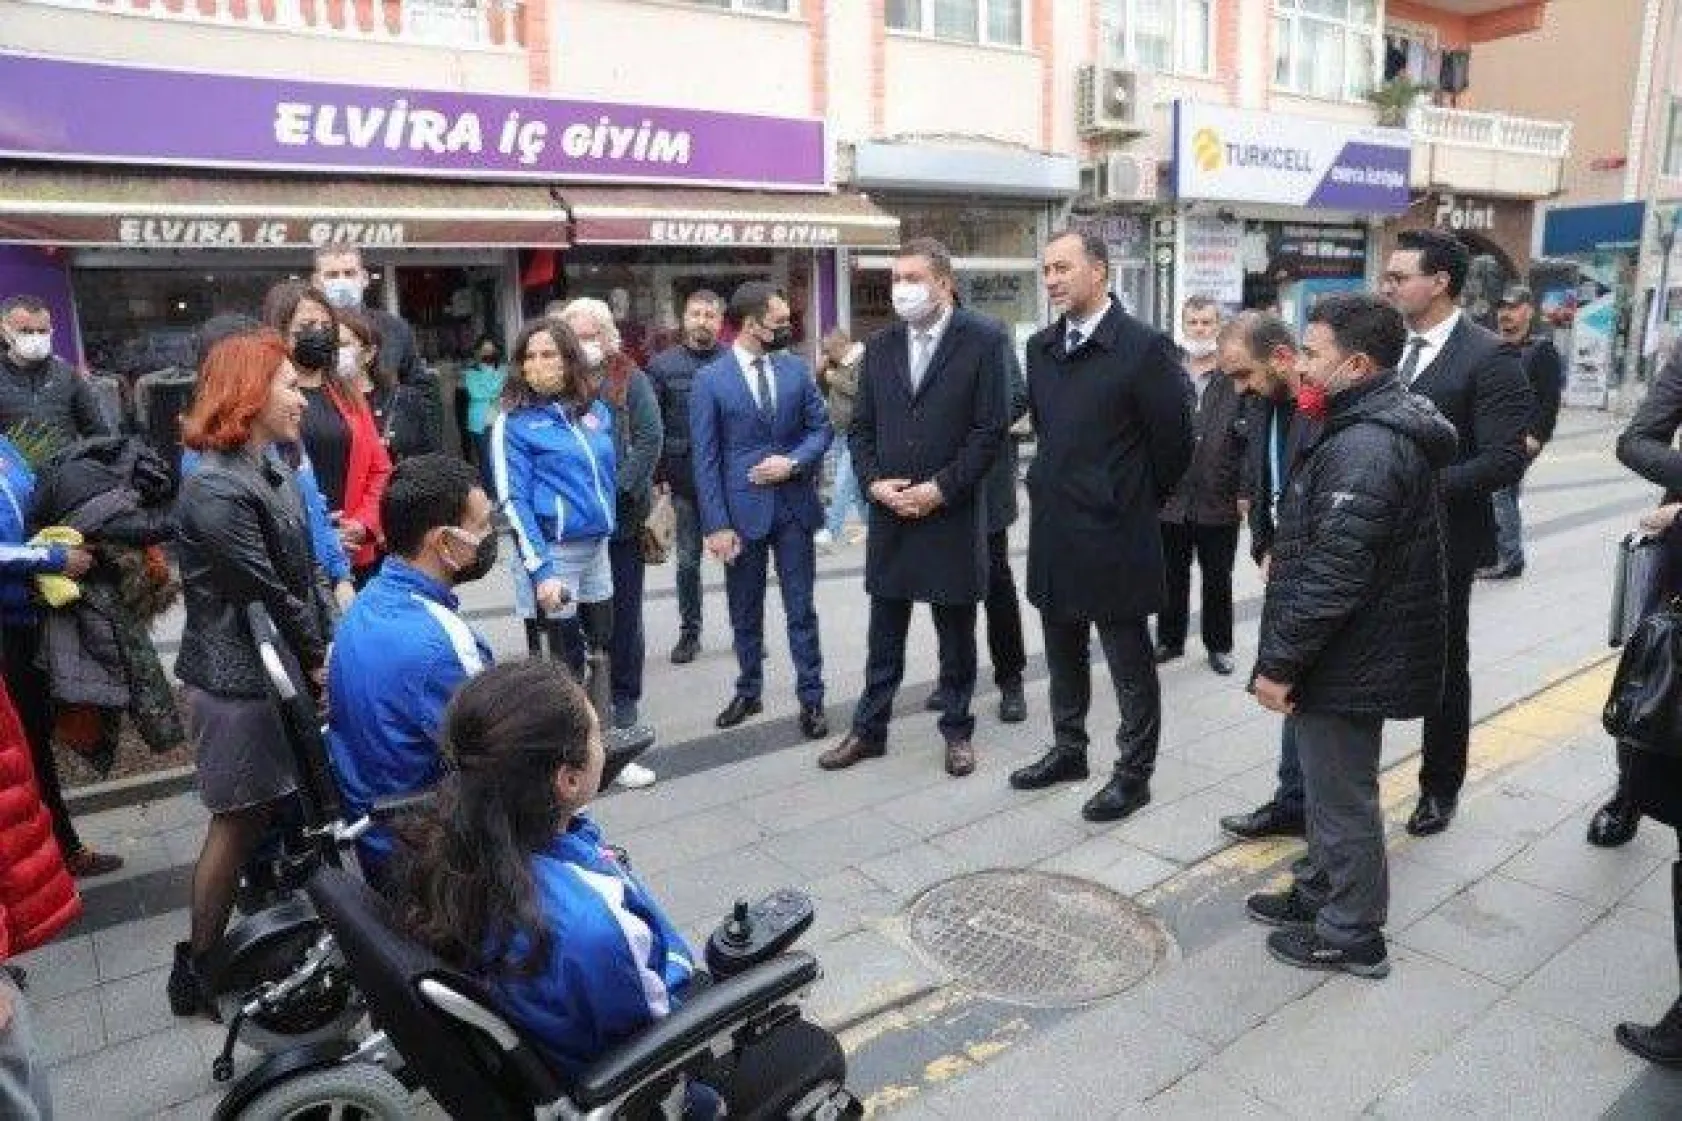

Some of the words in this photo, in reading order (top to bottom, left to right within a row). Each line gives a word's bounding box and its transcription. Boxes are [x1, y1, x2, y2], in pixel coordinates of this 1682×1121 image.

[274, 100, 482, 154] ELVİRA
[500, 110, 548, 164] İÇ
[562, 115, 691, 164] GİYİM
[1225, 142, 1312, 172] TURKCELL
[1435, 194, 1495, 231] Point
